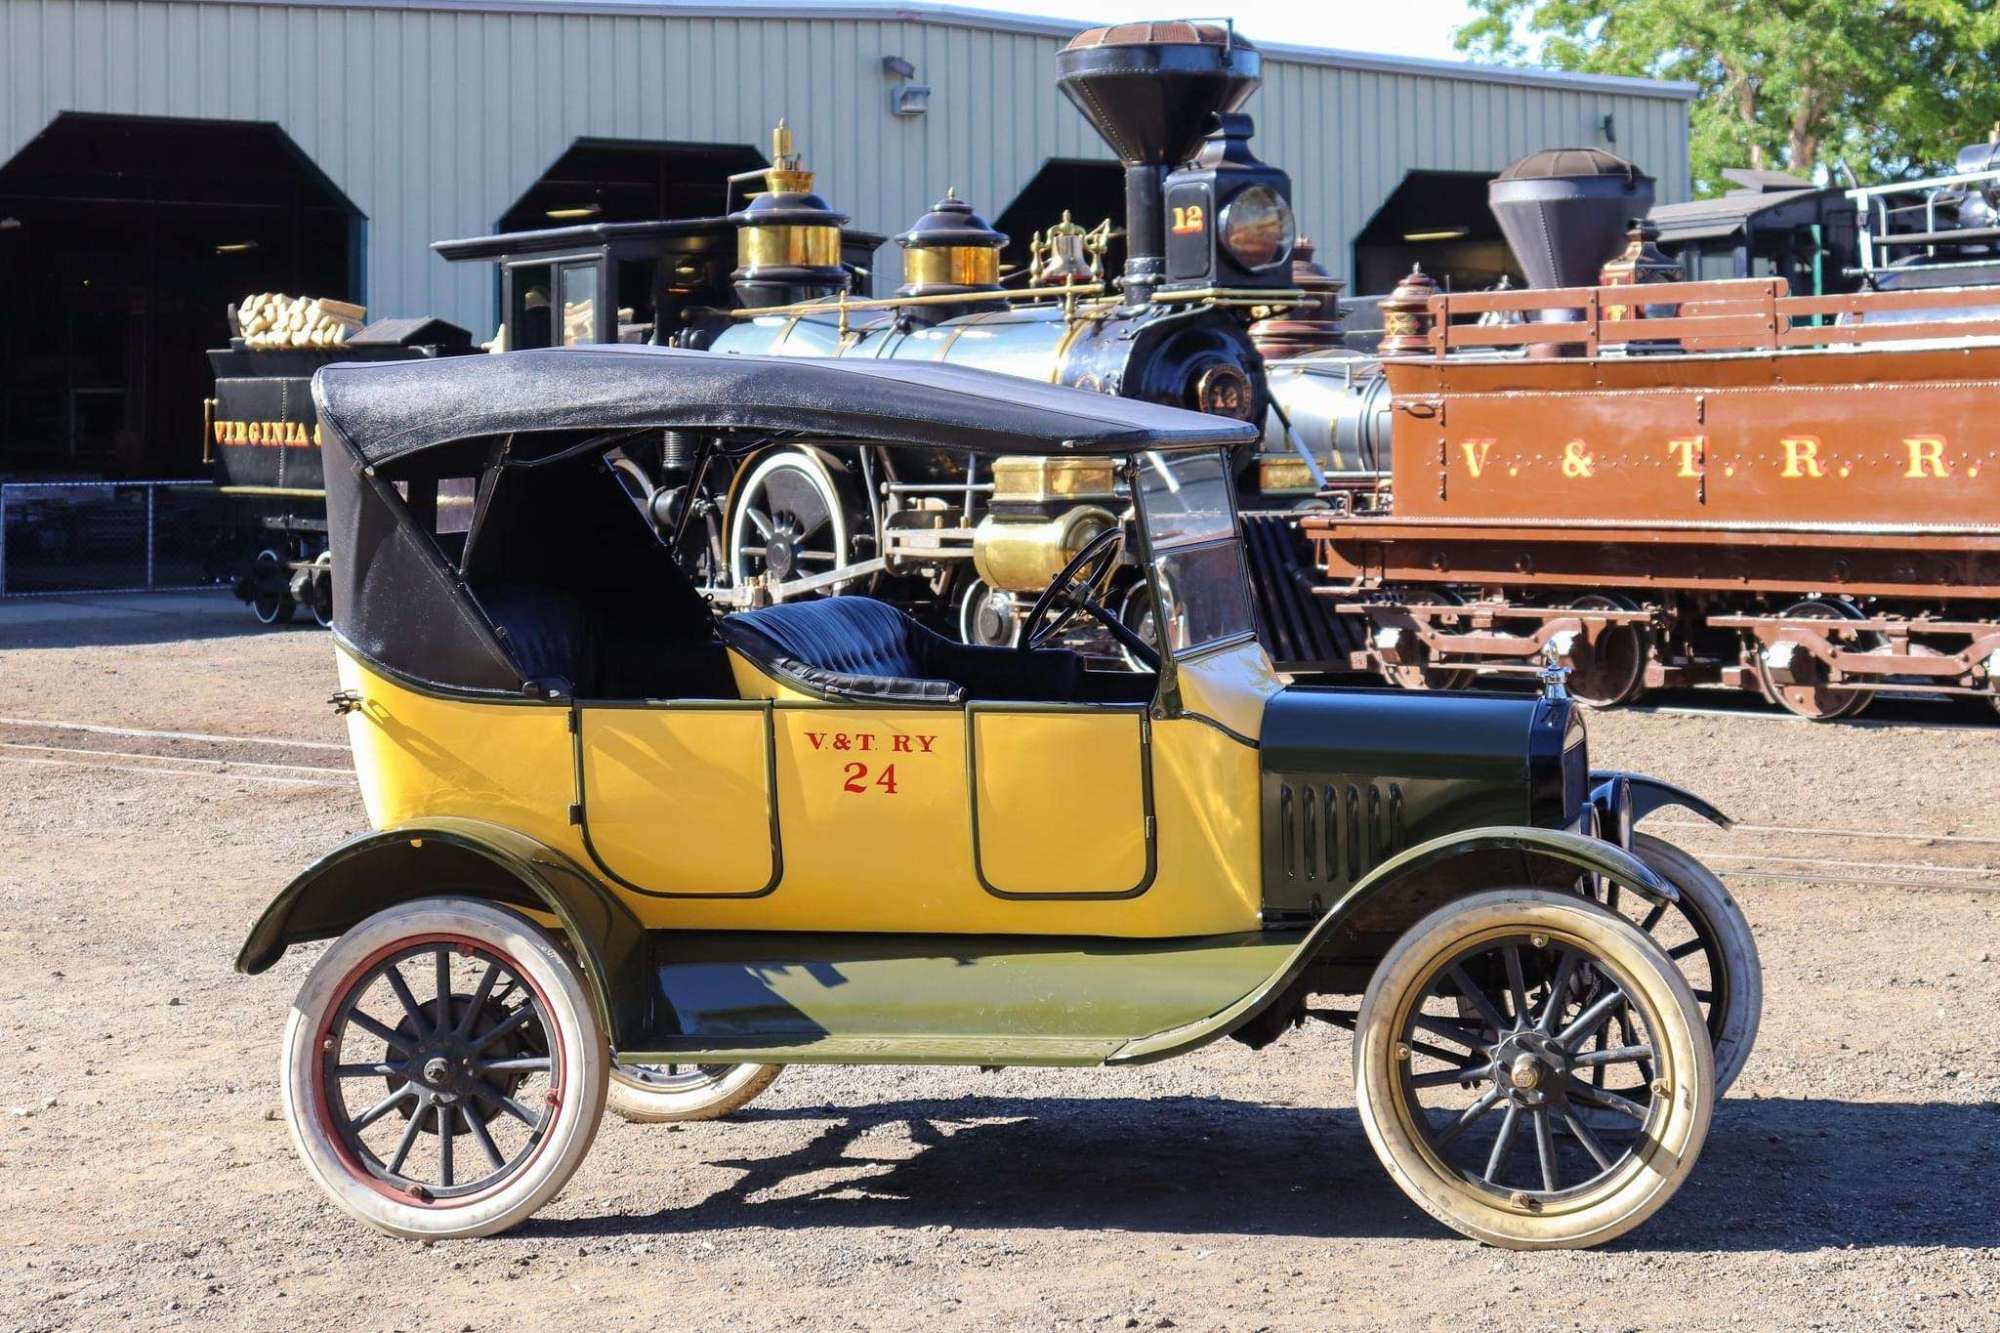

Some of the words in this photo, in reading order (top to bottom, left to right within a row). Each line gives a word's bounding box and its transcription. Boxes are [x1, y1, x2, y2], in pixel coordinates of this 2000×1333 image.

[1172, 205, 1203, 236] 12
[214, 421, 308, 446] VIRGINIA
[1562, 439, 1594, 478] &
[892, 735, 937, 752] RY
[844, 762, 897, 794] 24
